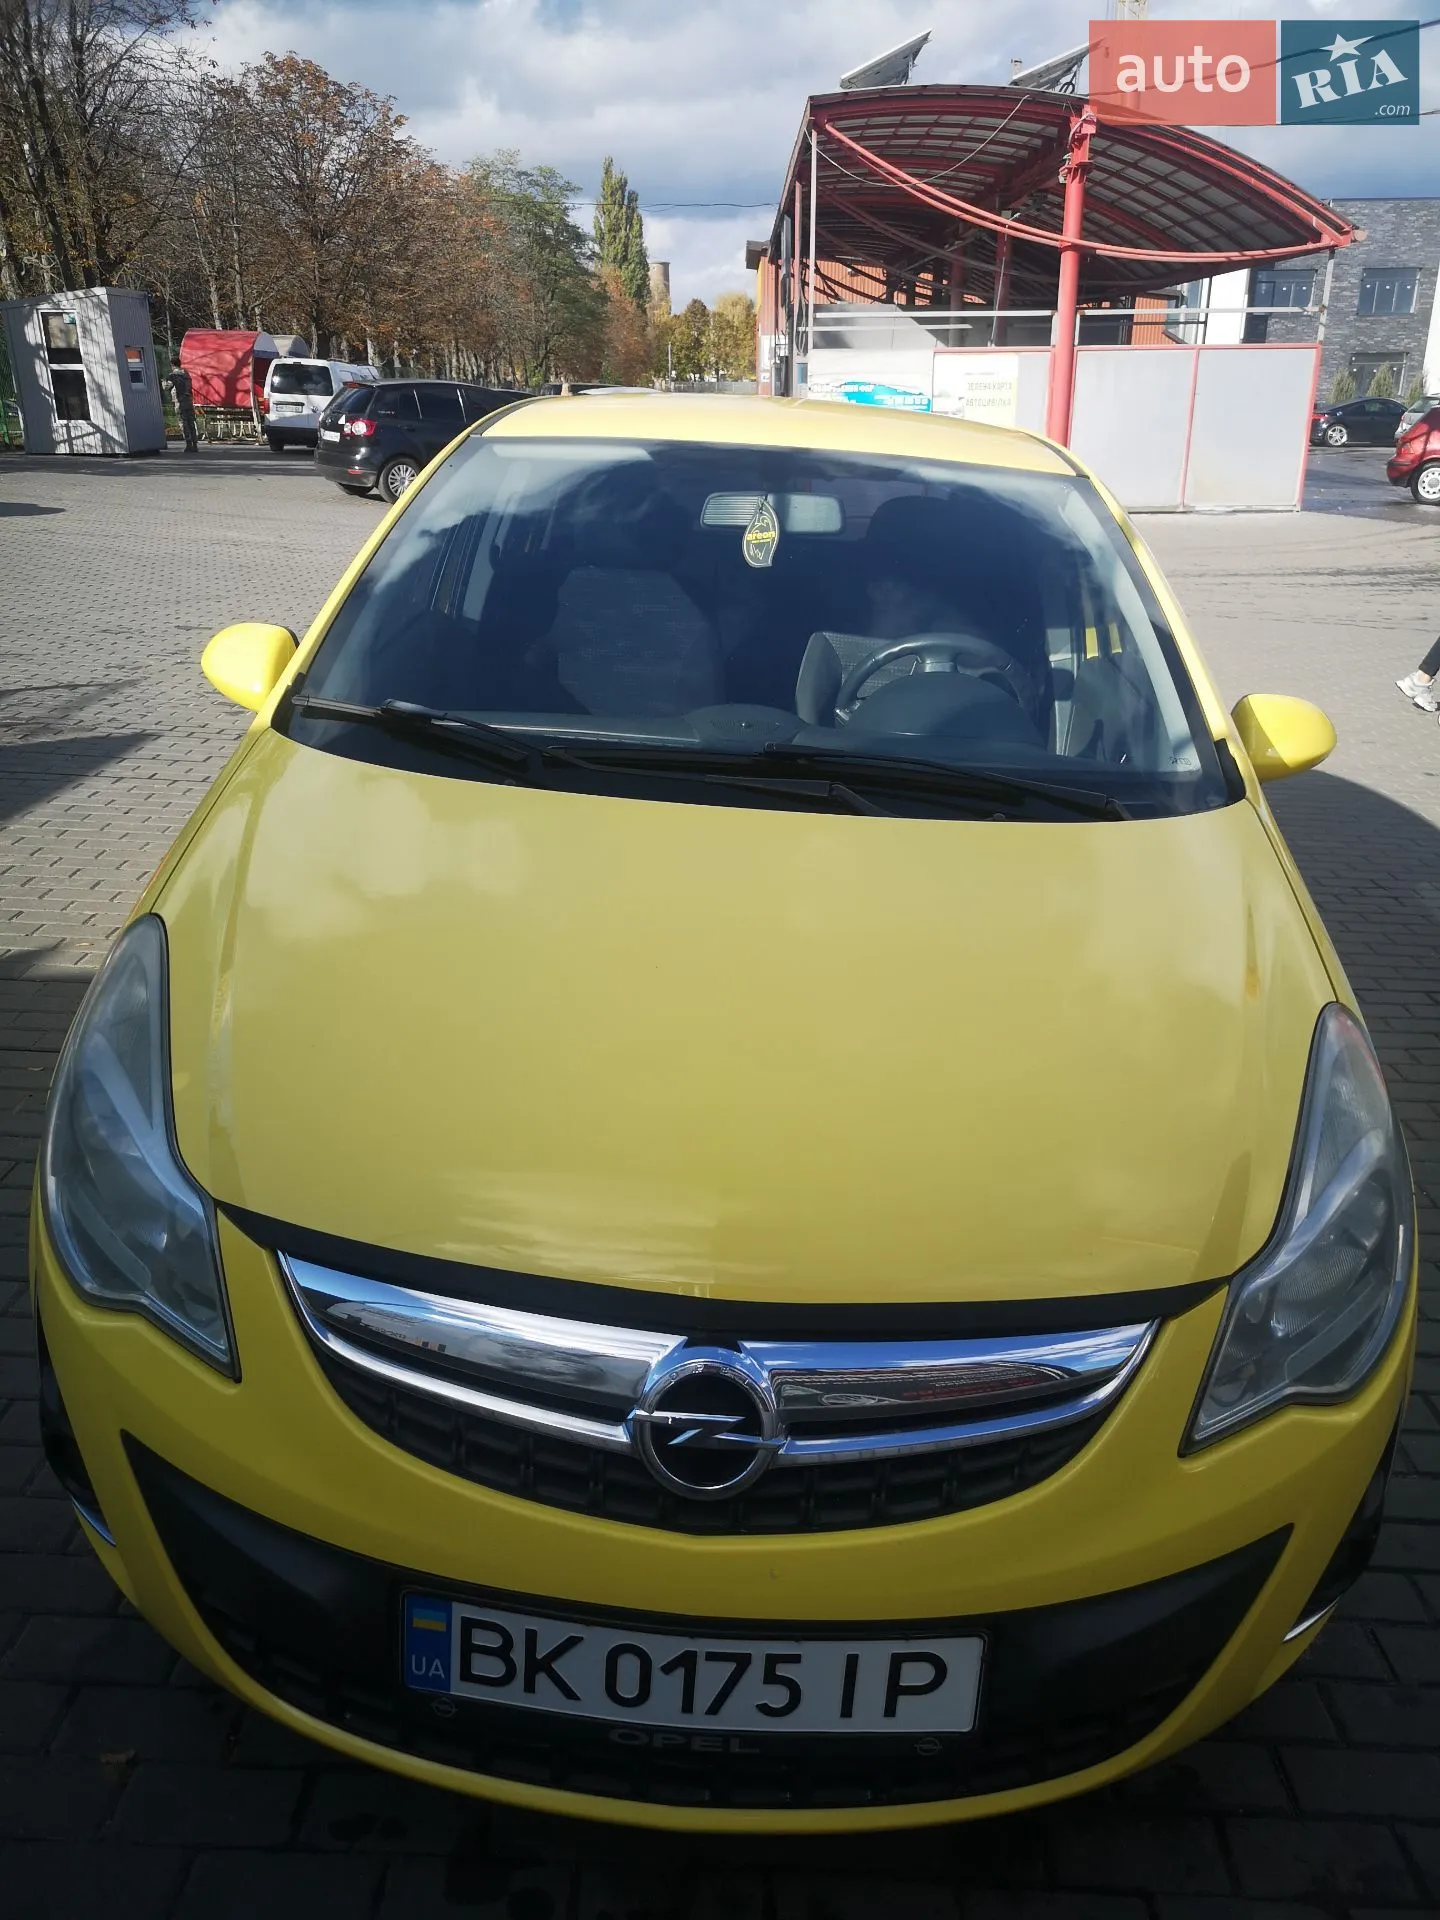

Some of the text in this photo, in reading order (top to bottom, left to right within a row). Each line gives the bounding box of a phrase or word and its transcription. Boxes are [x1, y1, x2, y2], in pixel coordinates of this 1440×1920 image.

[411, 1654, 446, 1680] UA
[459, 1616, 948, 1719] BK 0175 IP
[608, 1728, 760, 1754] OPEL
